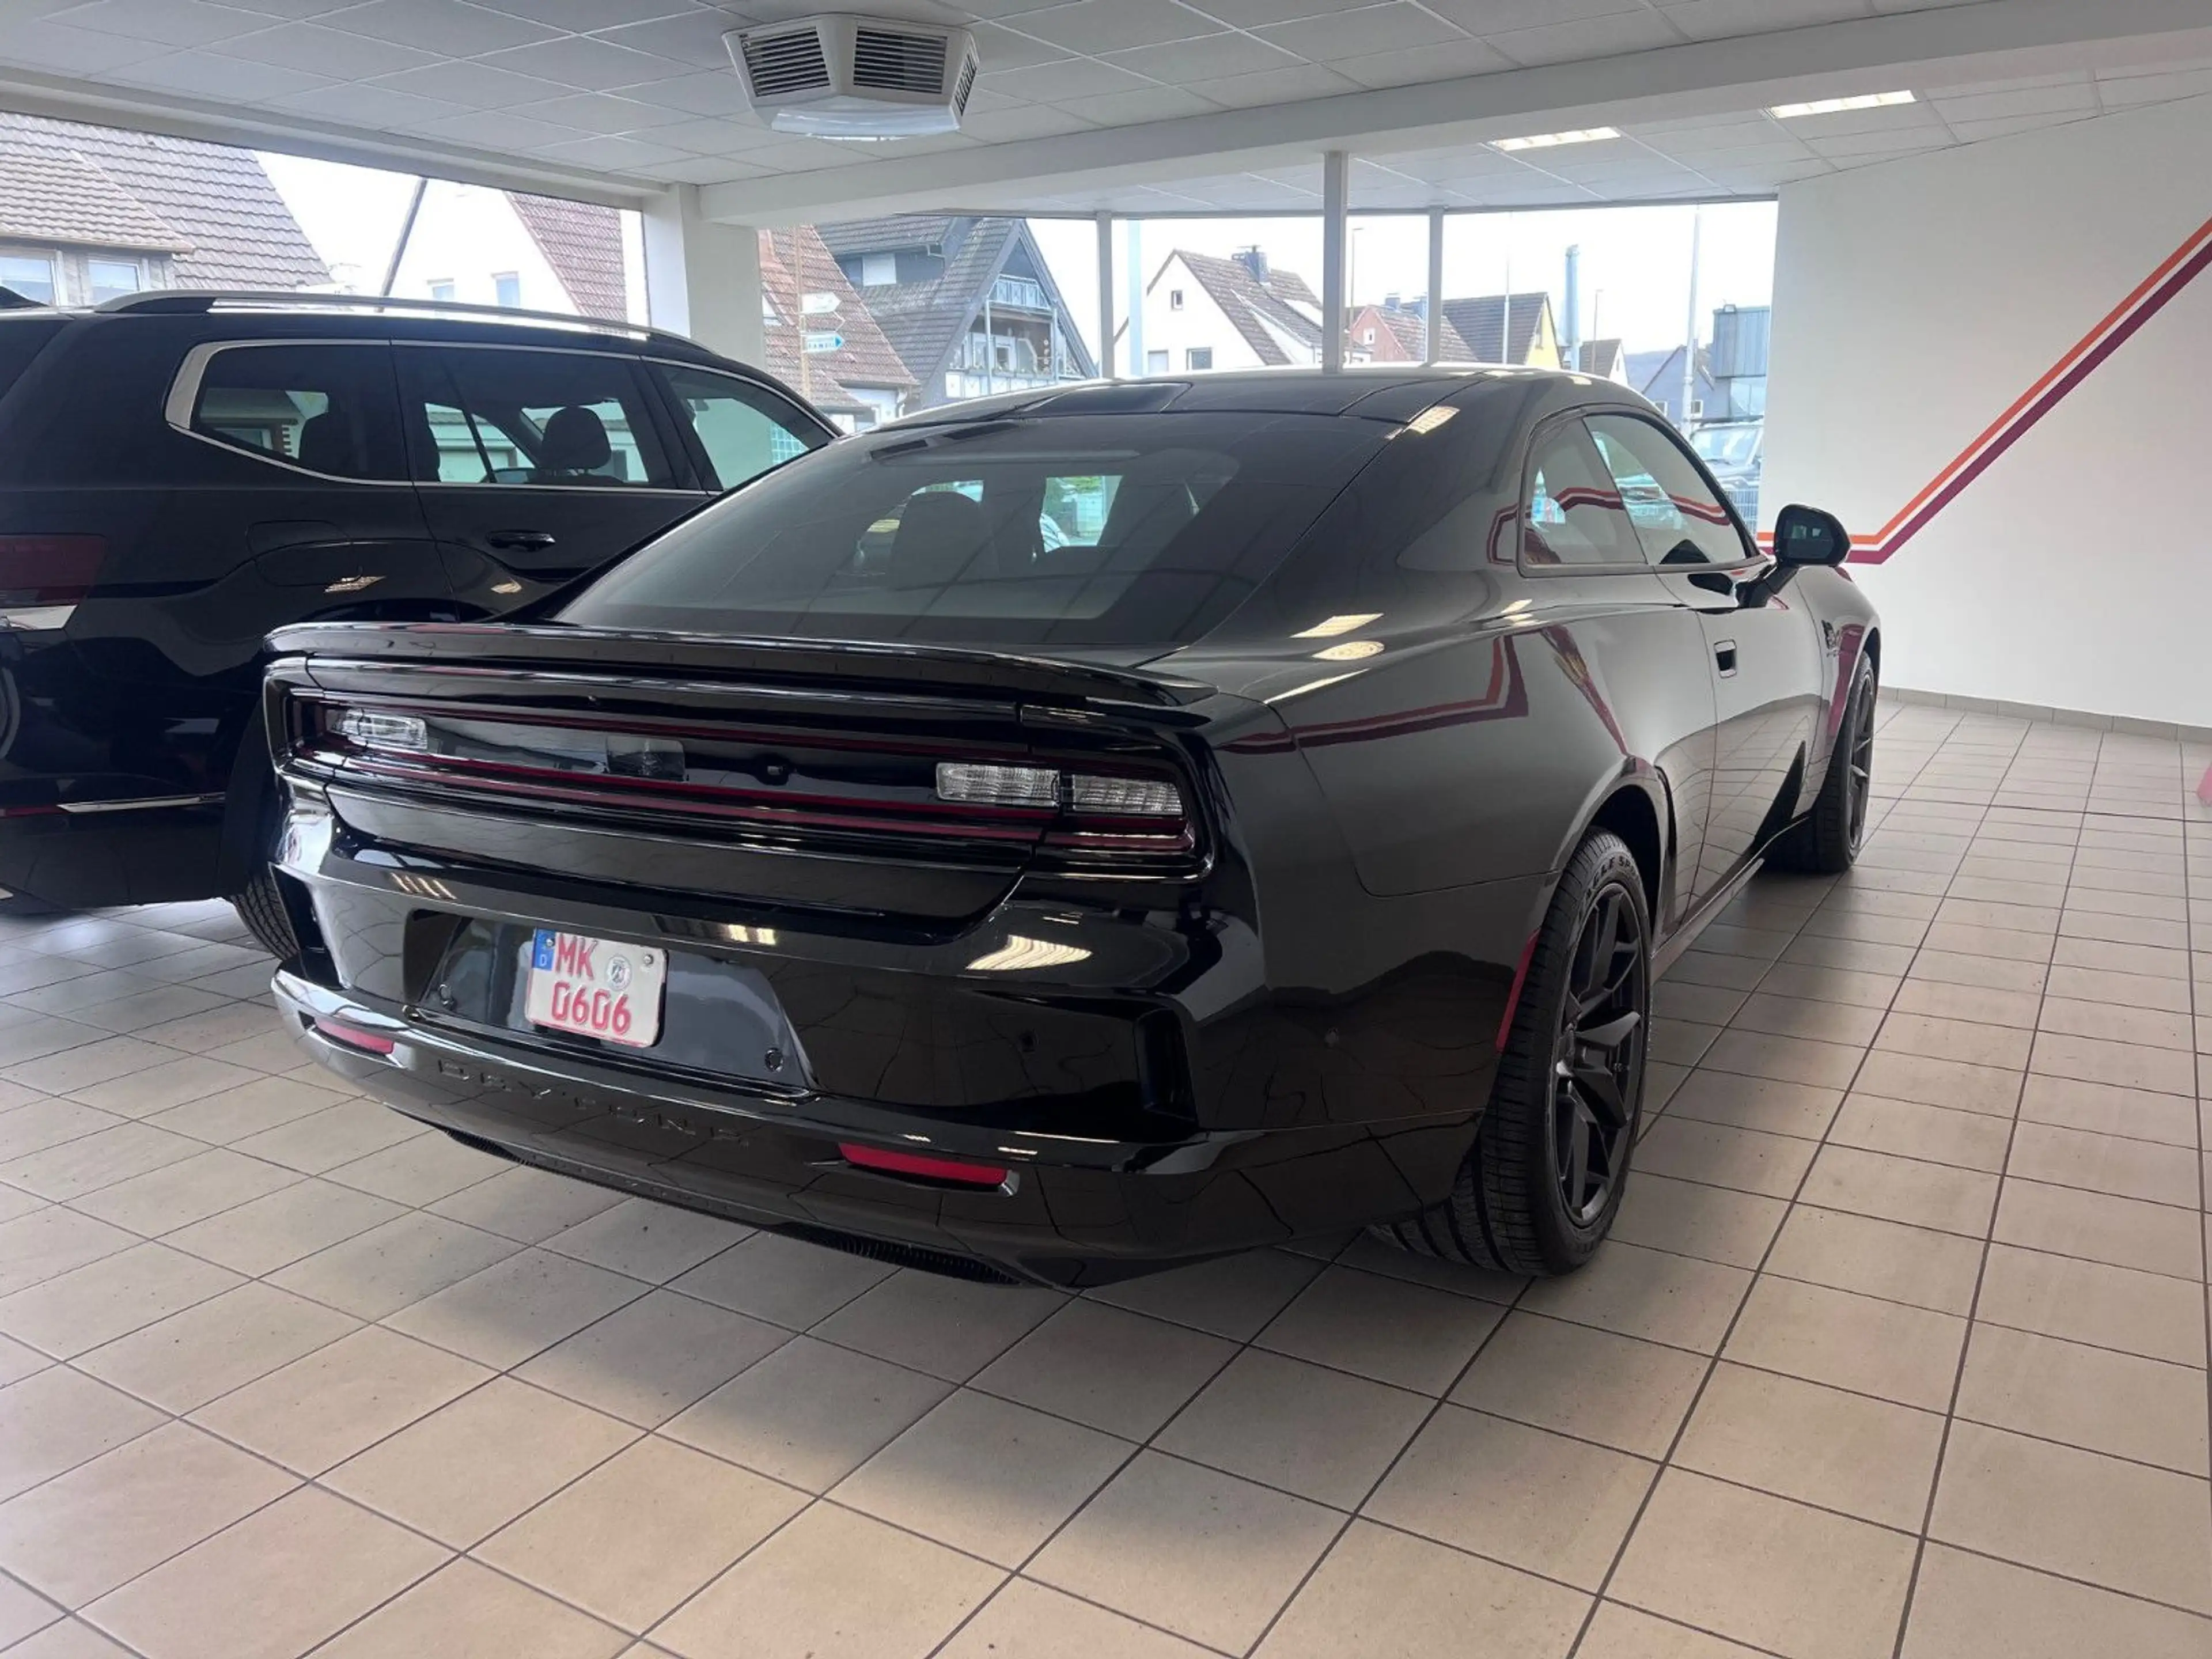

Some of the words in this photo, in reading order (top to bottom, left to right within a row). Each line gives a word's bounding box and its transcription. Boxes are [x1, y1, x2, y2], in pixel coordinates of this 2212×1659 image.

[539, 953, 547, 966] D
[555, 933, 598, 981] MK
[551, 980, 631, 1035] 0606
